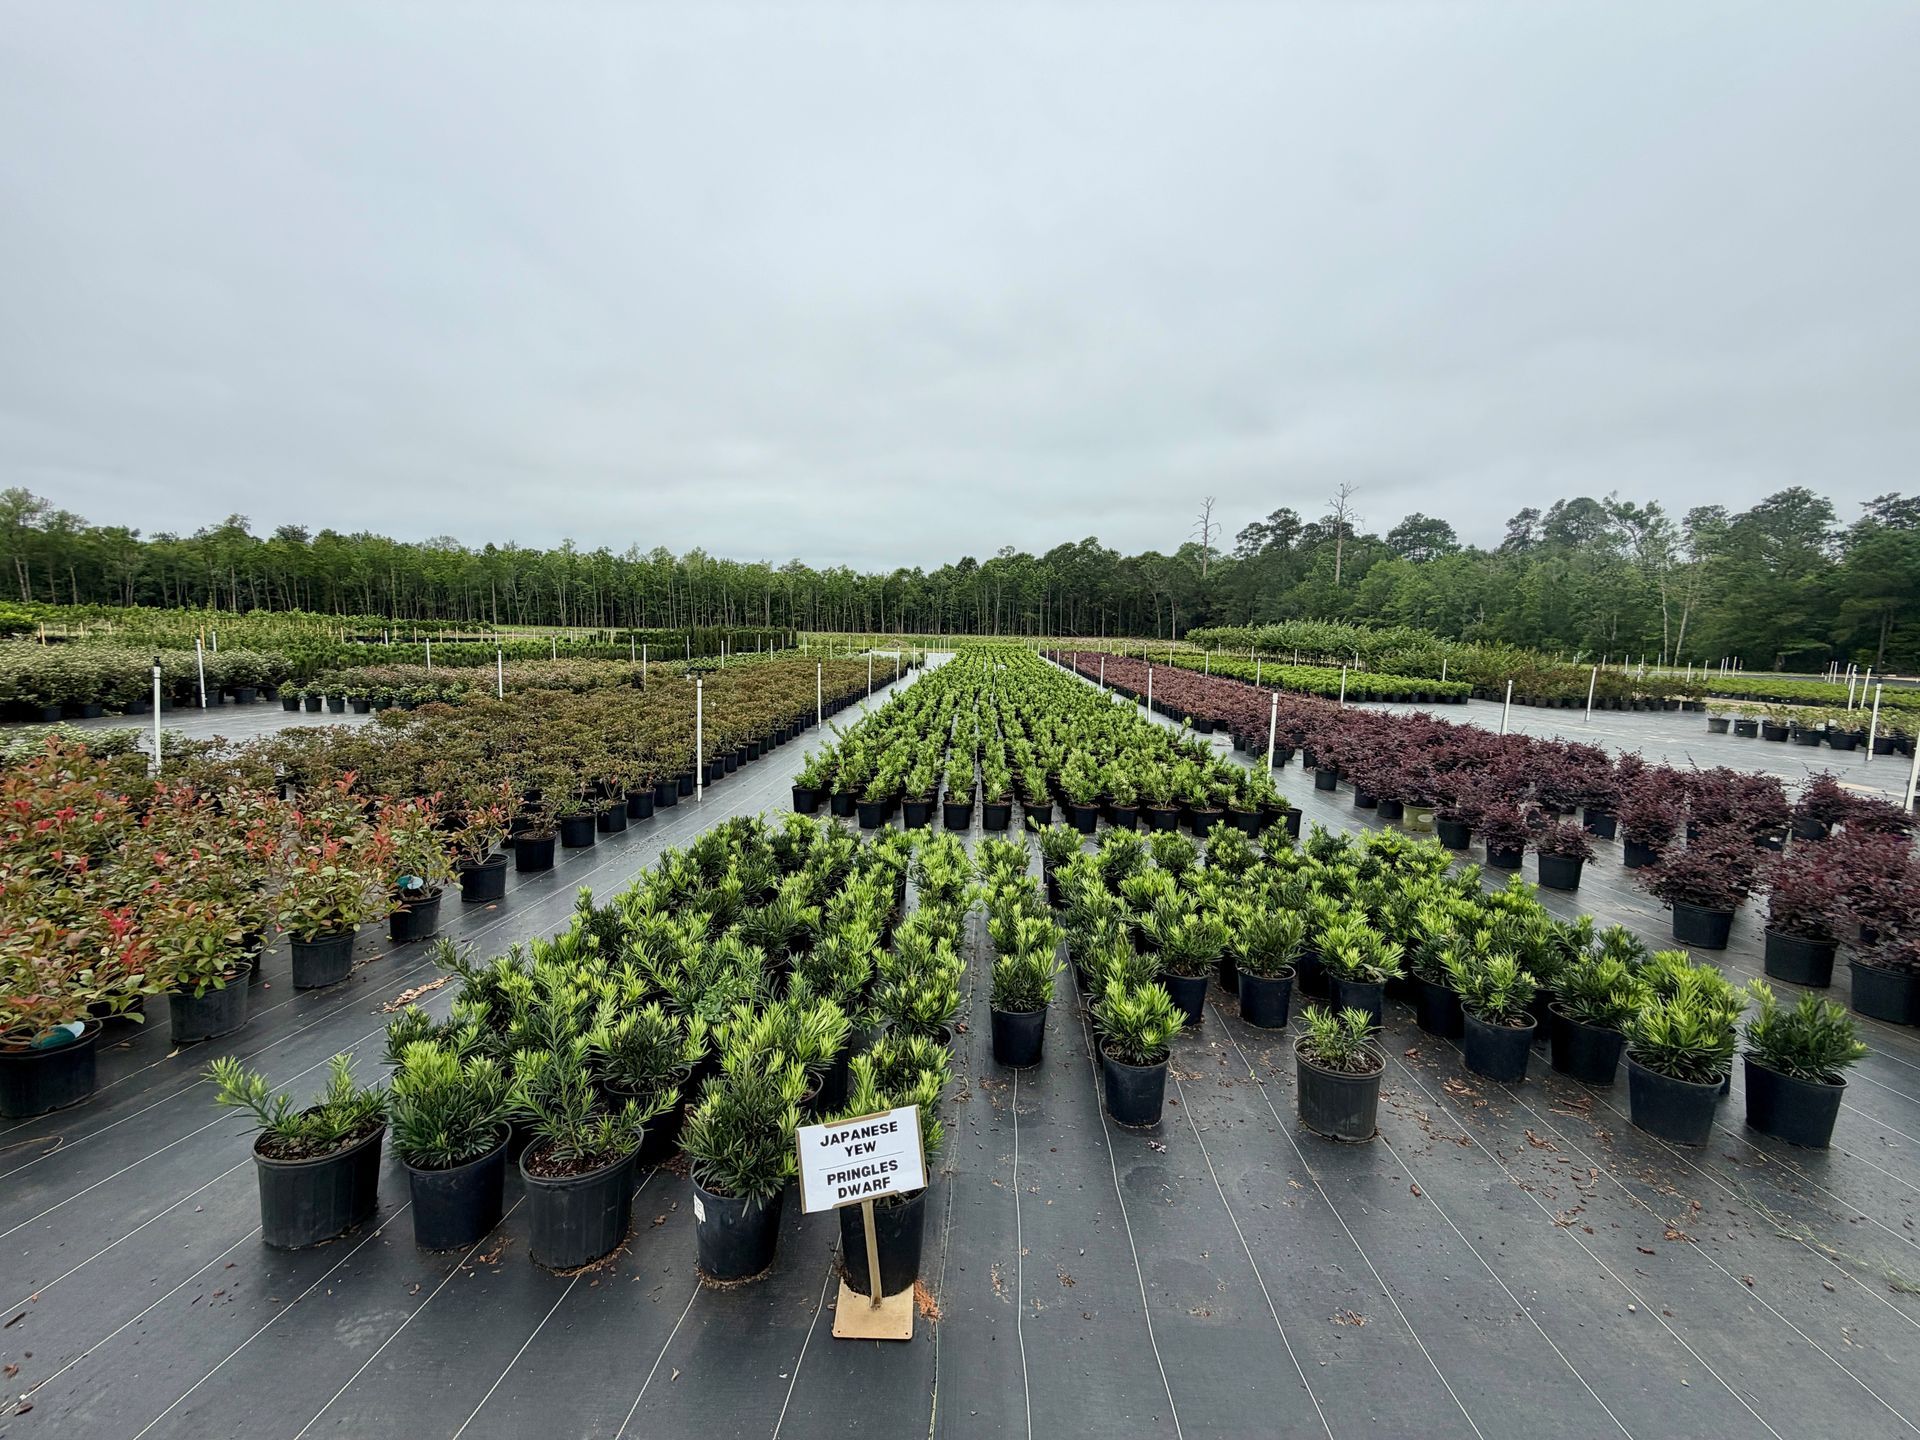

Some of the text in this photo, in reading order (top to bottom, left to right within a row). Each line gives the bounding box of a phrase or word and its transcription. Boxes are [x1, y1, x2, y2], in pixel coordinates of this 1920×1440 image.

[820, 1121, 898, 1147] JAPANESE
[845, 1141, 877, 1157] YEW
[827, 1160, 898, 1185] PRINGLES
[838, 1177, 890, 1199] DWARF
